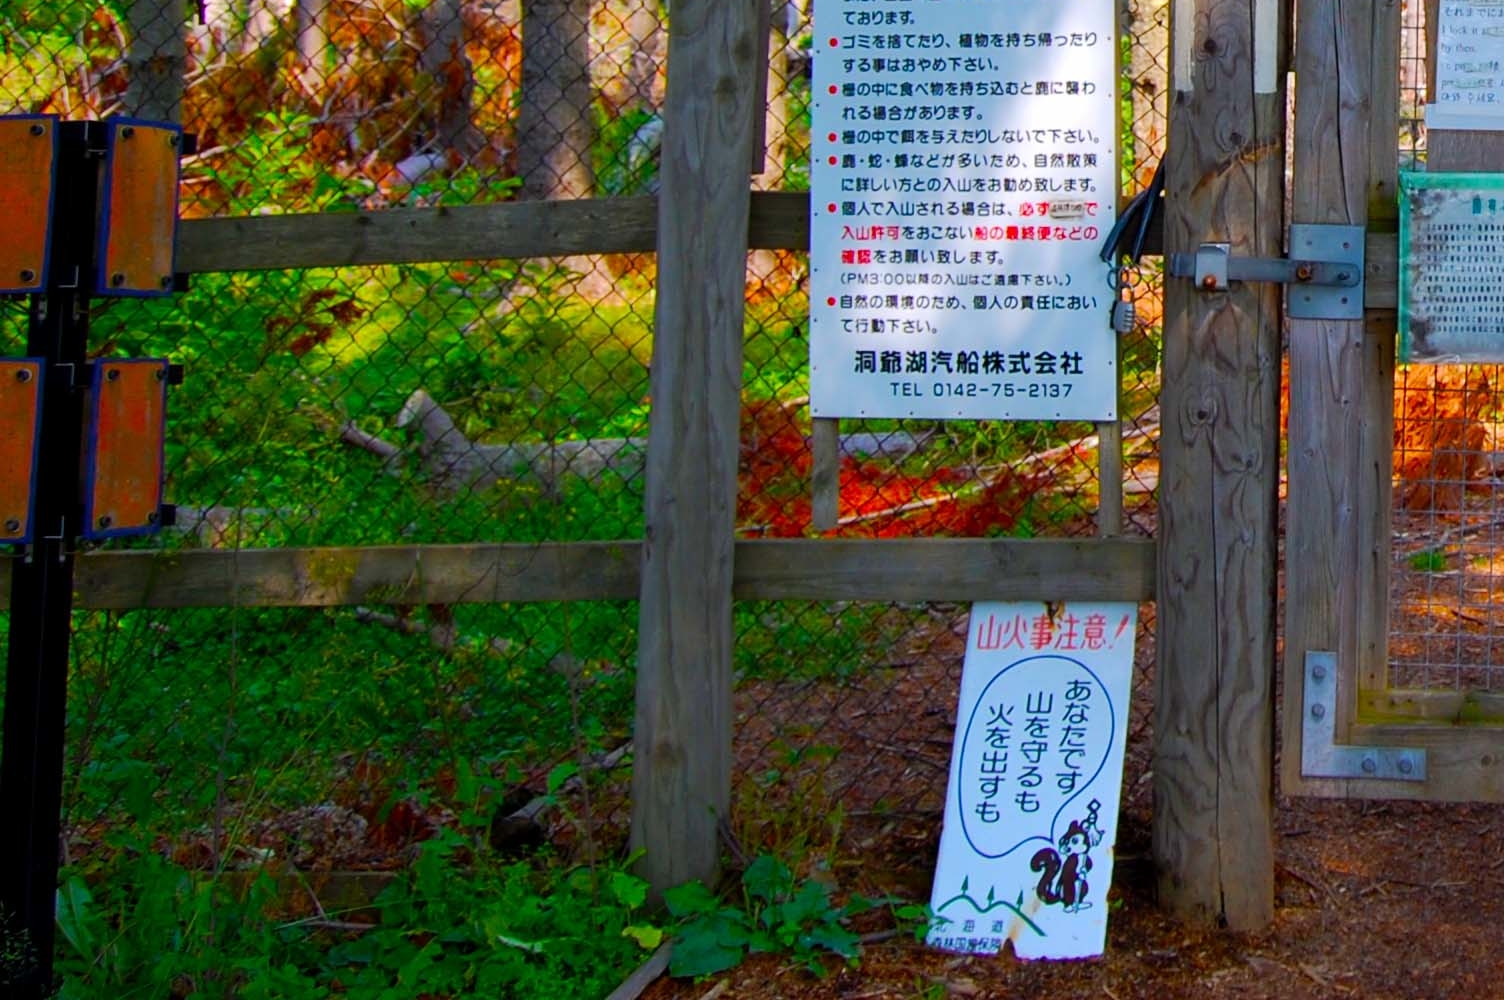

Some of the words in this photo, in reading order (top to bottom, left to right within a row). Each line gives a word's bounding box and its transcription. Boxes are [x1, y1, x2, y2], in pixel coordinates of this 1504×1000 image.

[843, 10, 915, 25] ております。
[842, 32, 1098, 49] ゴミを捨てたり、植物を持ち帰ったり
[842, 57, 999, 73] する事はおやめ下さい。
[842, 105, 983, 120] れる場合があります。
[841, 177, 1097, 193] に詳しい方との入山をお勧め致します。
[840, 294, 1098, 311] 自然の環境のため、個人の責任におい
[841, 318, 938, 335] て行動下さい。
[854, 351, 1084, 376] 洞爺湖汽船株式会社
[890, 382, 923, 398] TEL
[933, 383, 1073, 398] 0142-75-2137
[1055, 679, 1093, 795] あなたです
[1014, 690, 1054, 814] 山を守るも
[975, 703, 1014, 824] 火を出すも
